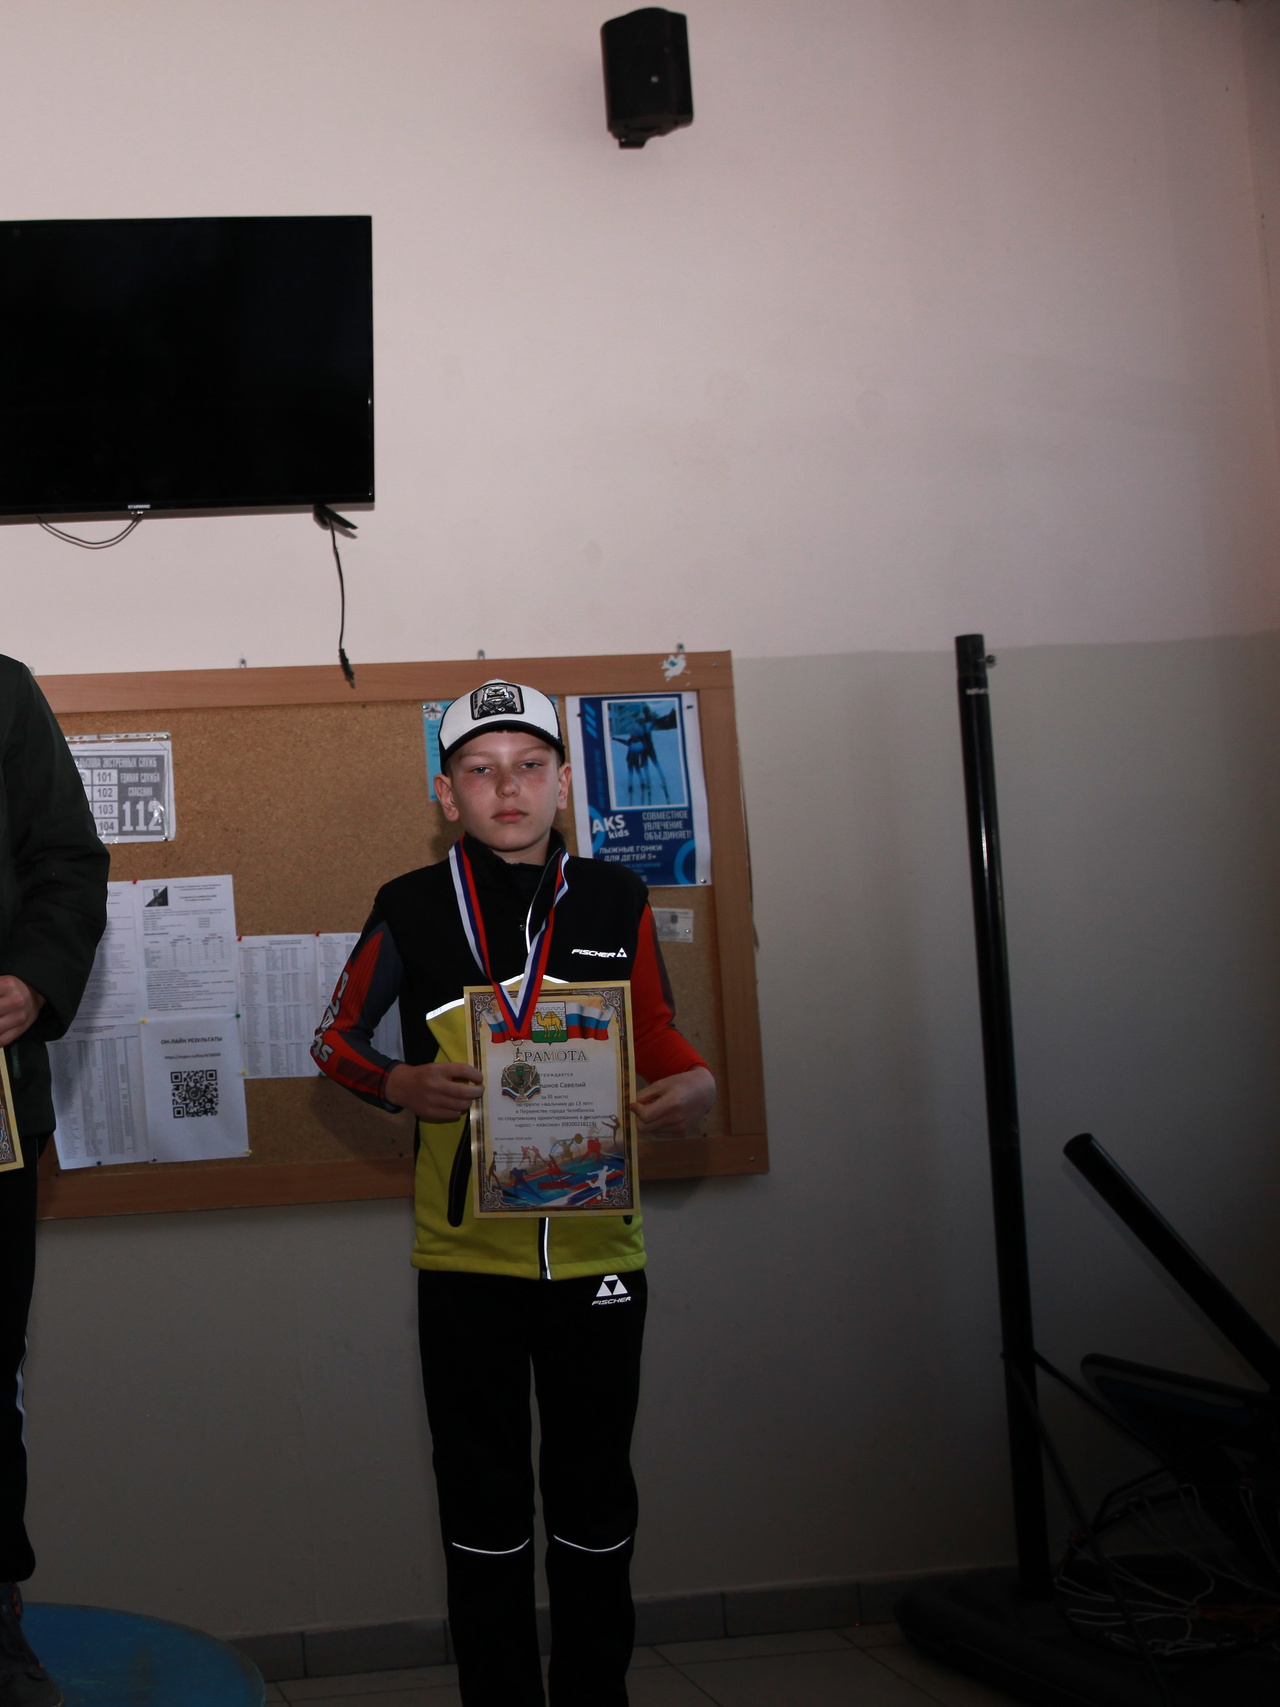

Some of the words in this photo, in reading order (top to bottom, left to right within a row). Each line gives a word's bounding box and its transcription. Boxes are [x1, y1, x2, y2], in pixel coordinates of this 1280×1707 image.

[96, 772, 112, 783] 101
[97, 787, 113, 798] 102
[98, 804, 114, 815] 103
[642, 809, 688, 821] СОВМЕСТНОЕ
[122, 800, 162, 832] 112
[99, 821, 114, 832] 104
[592, 814, 626, 834] AKS
[642, 820, 683, 831] УВЛЕЧЕНИЕ
[608, 829, 630, 840] kids
[644, 830, 693, 841] ОБЪЕДИНЯЕТ!
[599, 845, 634, 854] ЛЫЖНЫЕ
[636, 844, 663, 852] ГОНКИ
[604, 854, 620, 862] ДЛЯ
[620, 852, 646, 862] ДЕТЕЙ
[571, 948, 616, 958] FISCHER
[592, 1296, 631, 1306] FISCHER
